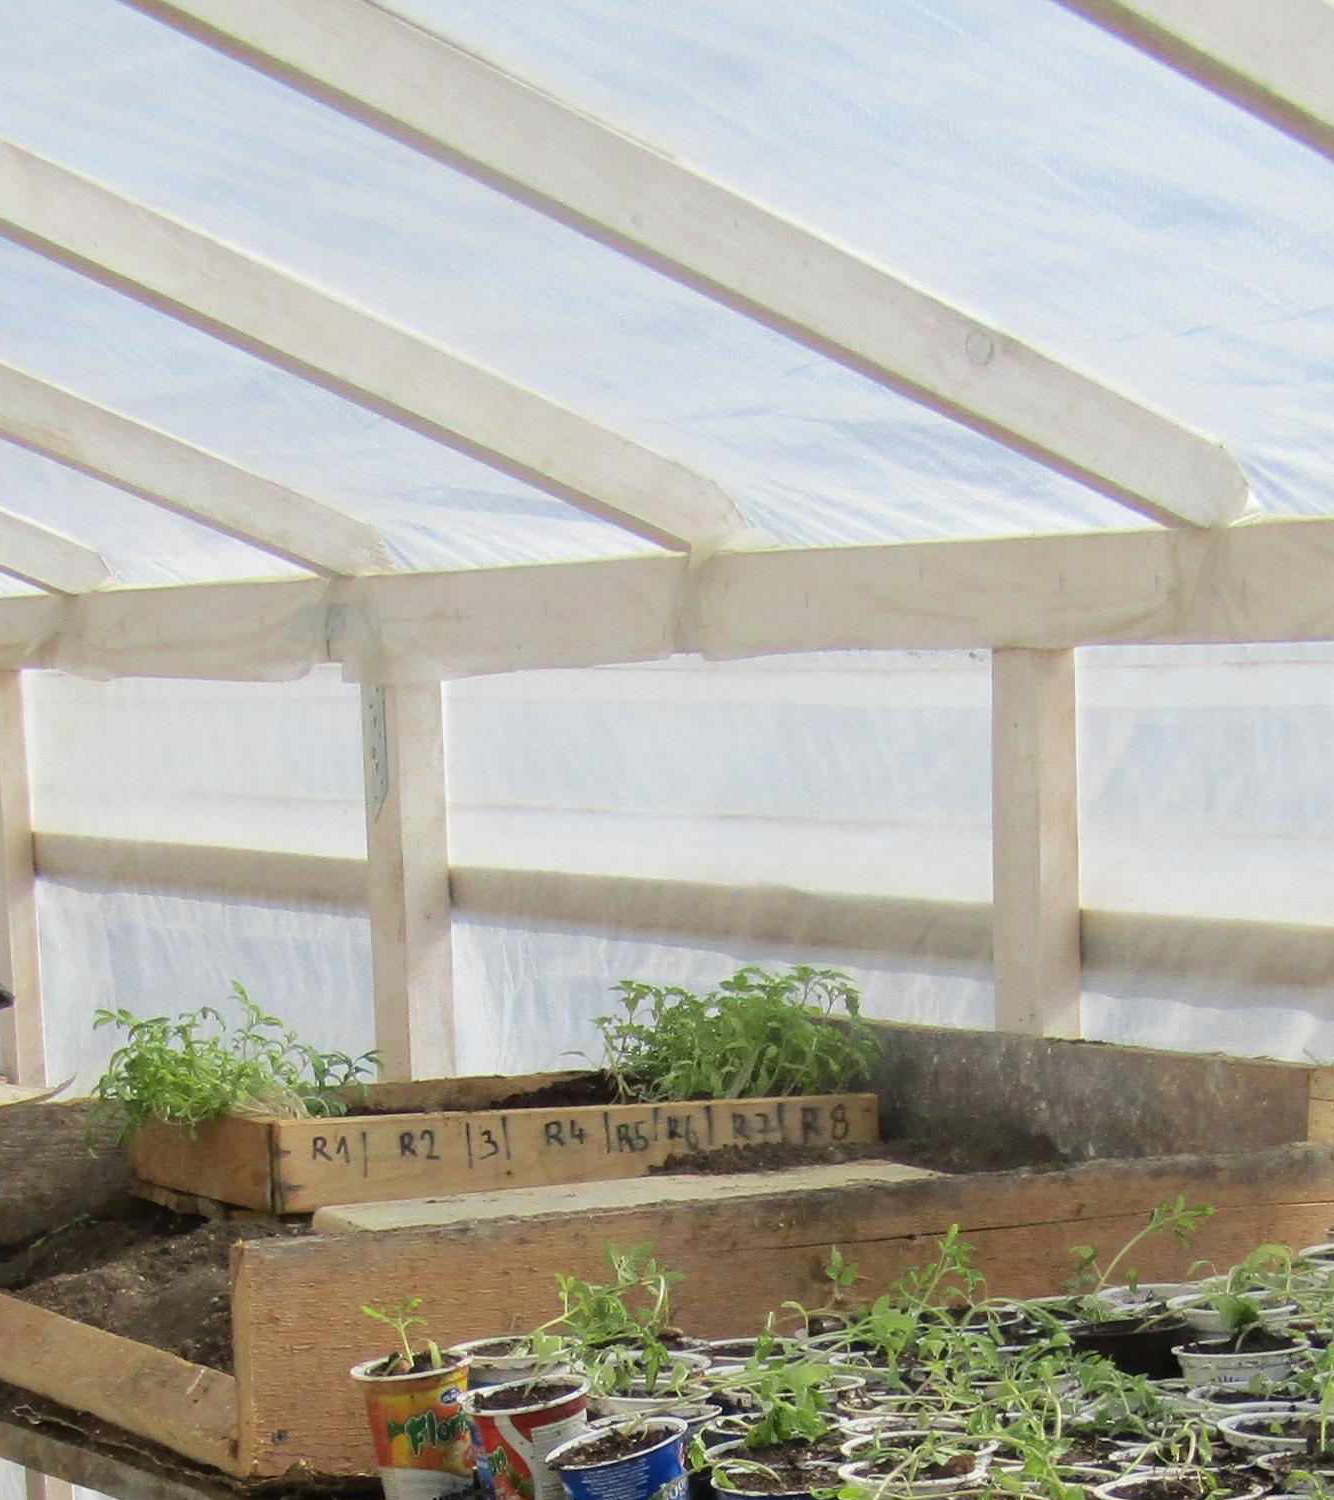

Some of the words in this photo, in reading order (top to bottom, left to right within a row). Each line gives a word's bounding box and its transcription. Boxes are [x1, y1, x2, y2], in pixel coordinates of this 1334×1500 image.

[312, 1136, 351, 1164] R1
[399, 1129, 441, 1161] R2
[543, 1119, 588, 1147] R4
[616, 1120, 649, 1153] R5
[667, 1115, 699, 1151] R6
[801, 1103, 849, 1144] R8
